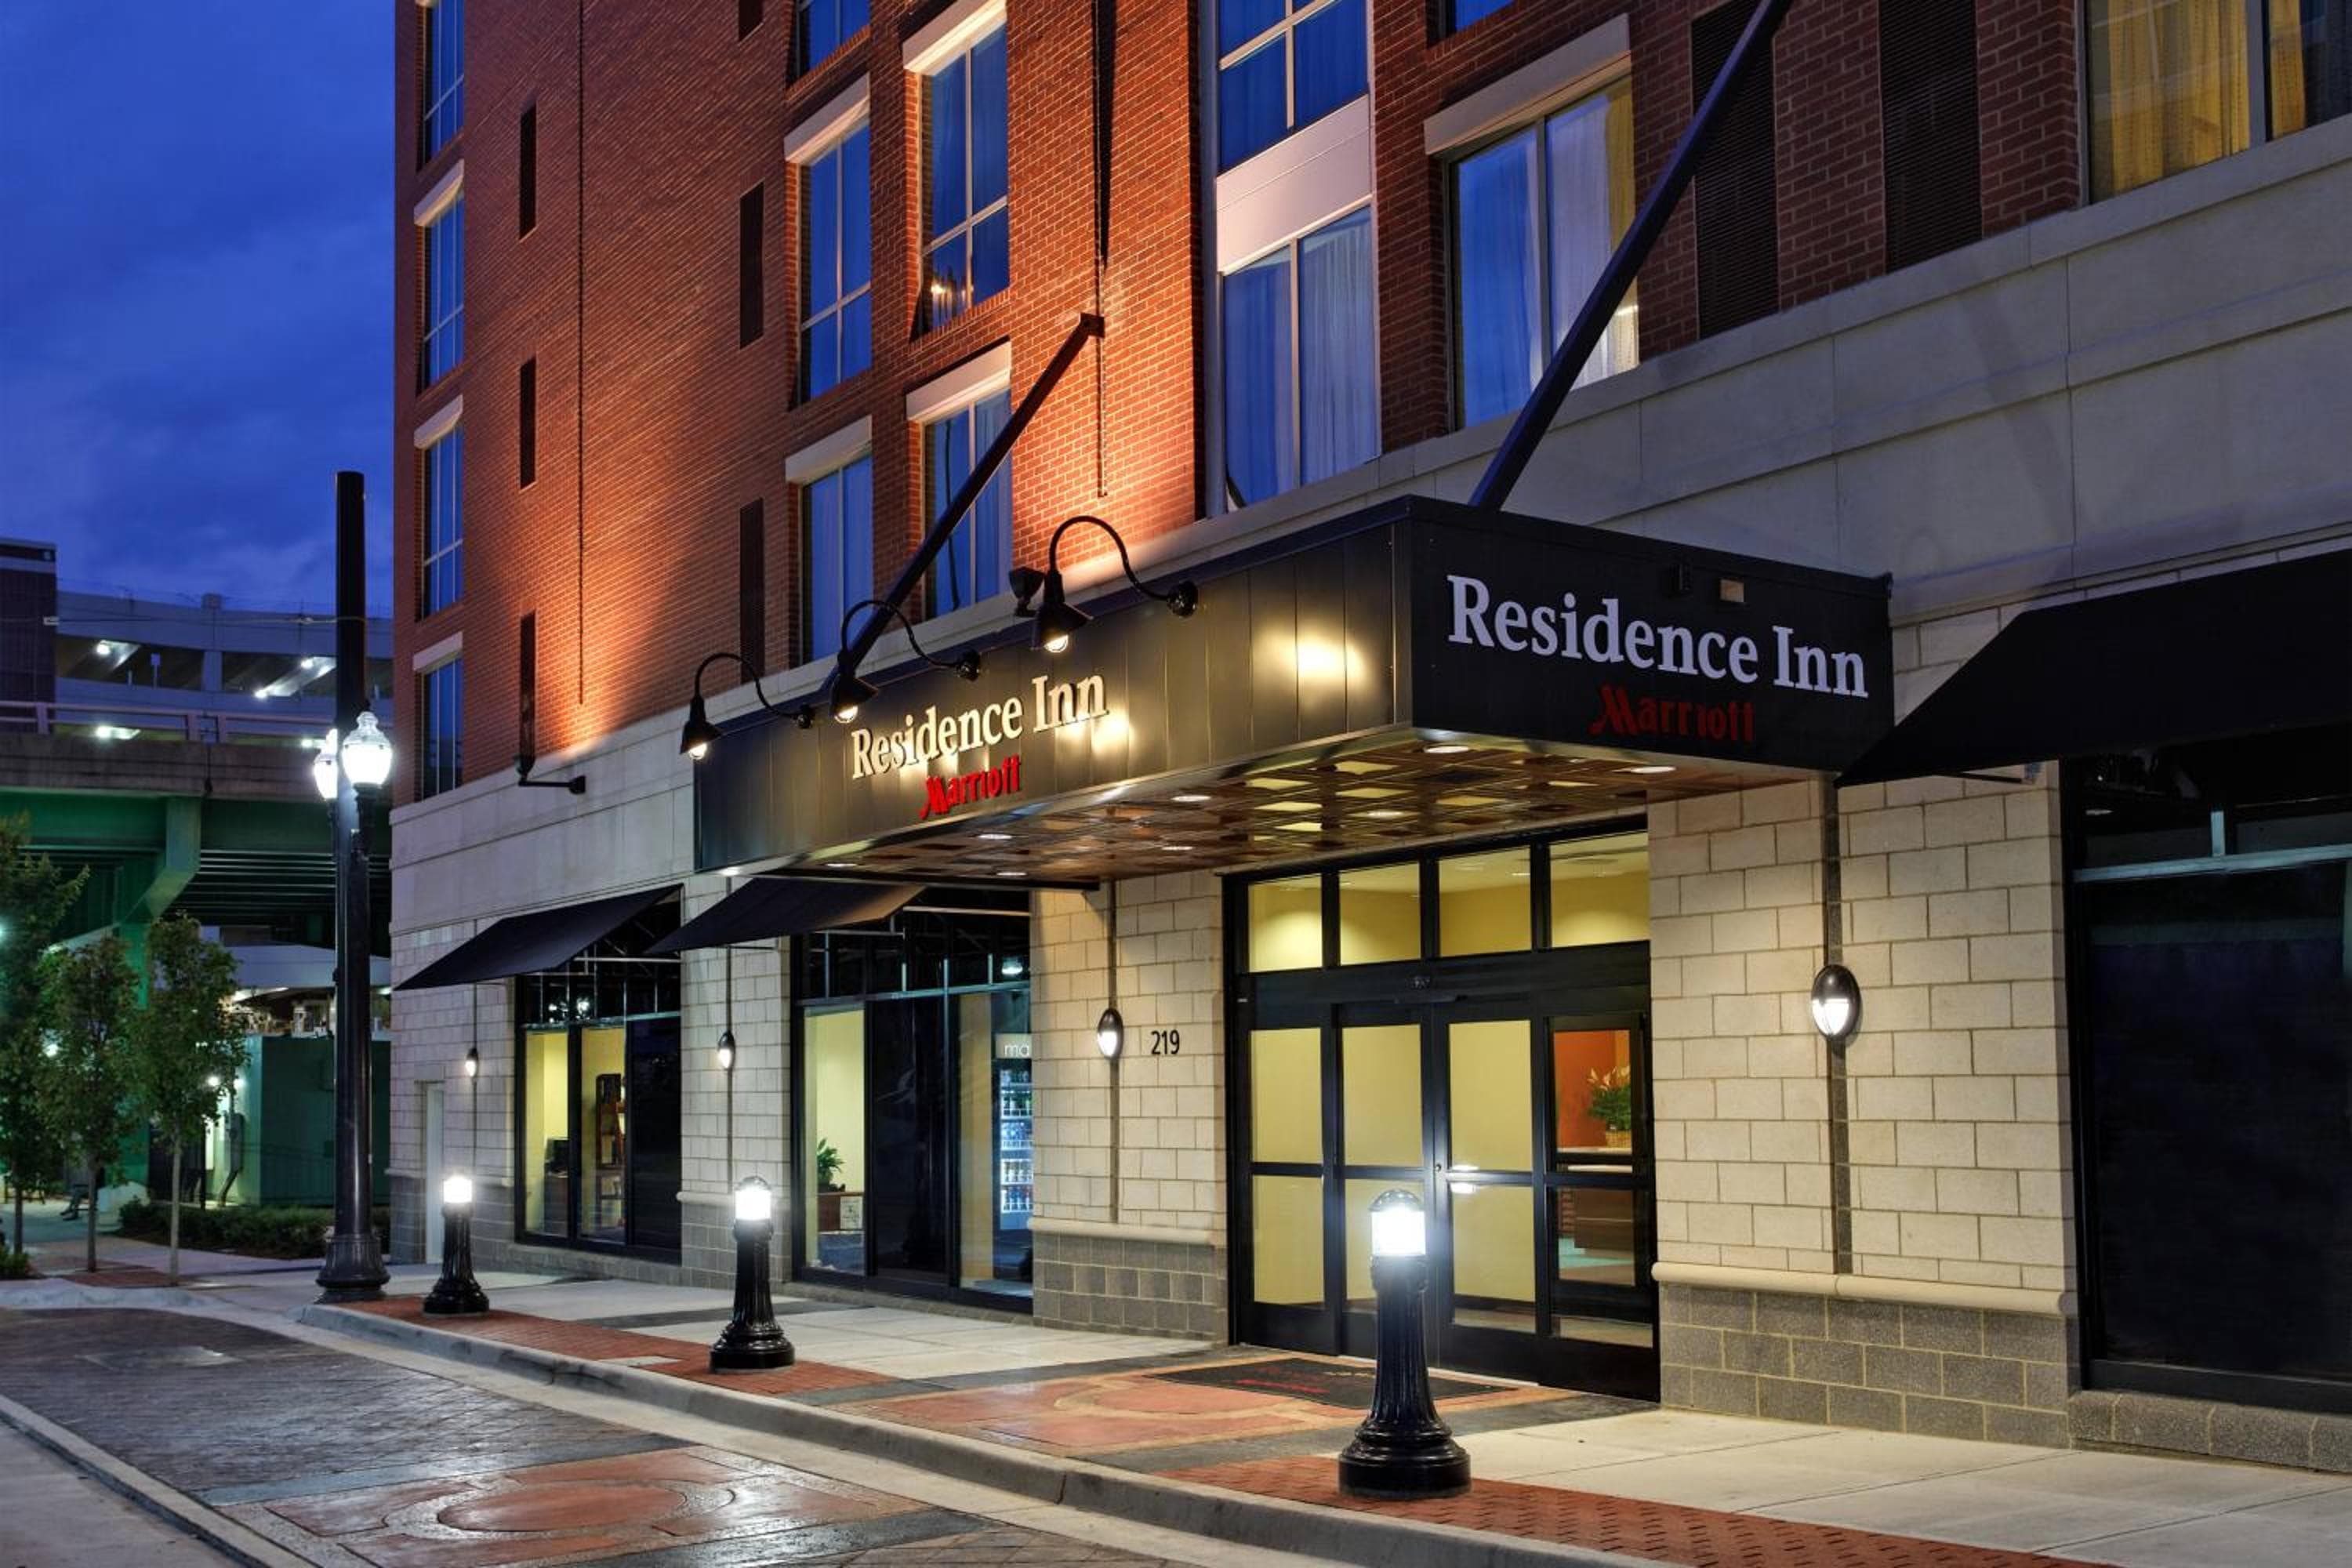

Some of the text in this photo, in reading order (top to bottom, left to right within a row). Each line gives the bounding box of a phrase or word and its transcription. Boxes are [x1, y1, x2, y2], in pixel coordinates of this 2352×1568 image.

[1448, 575, 1869, 699] Residence Inn
[851, 674, 1109, 779] Residence Inn
[1589, 684, 1755, 742] Marriott
[920, 754, 1022, 819] Marriott
[1151, 1029, 1180, 1054] 219
